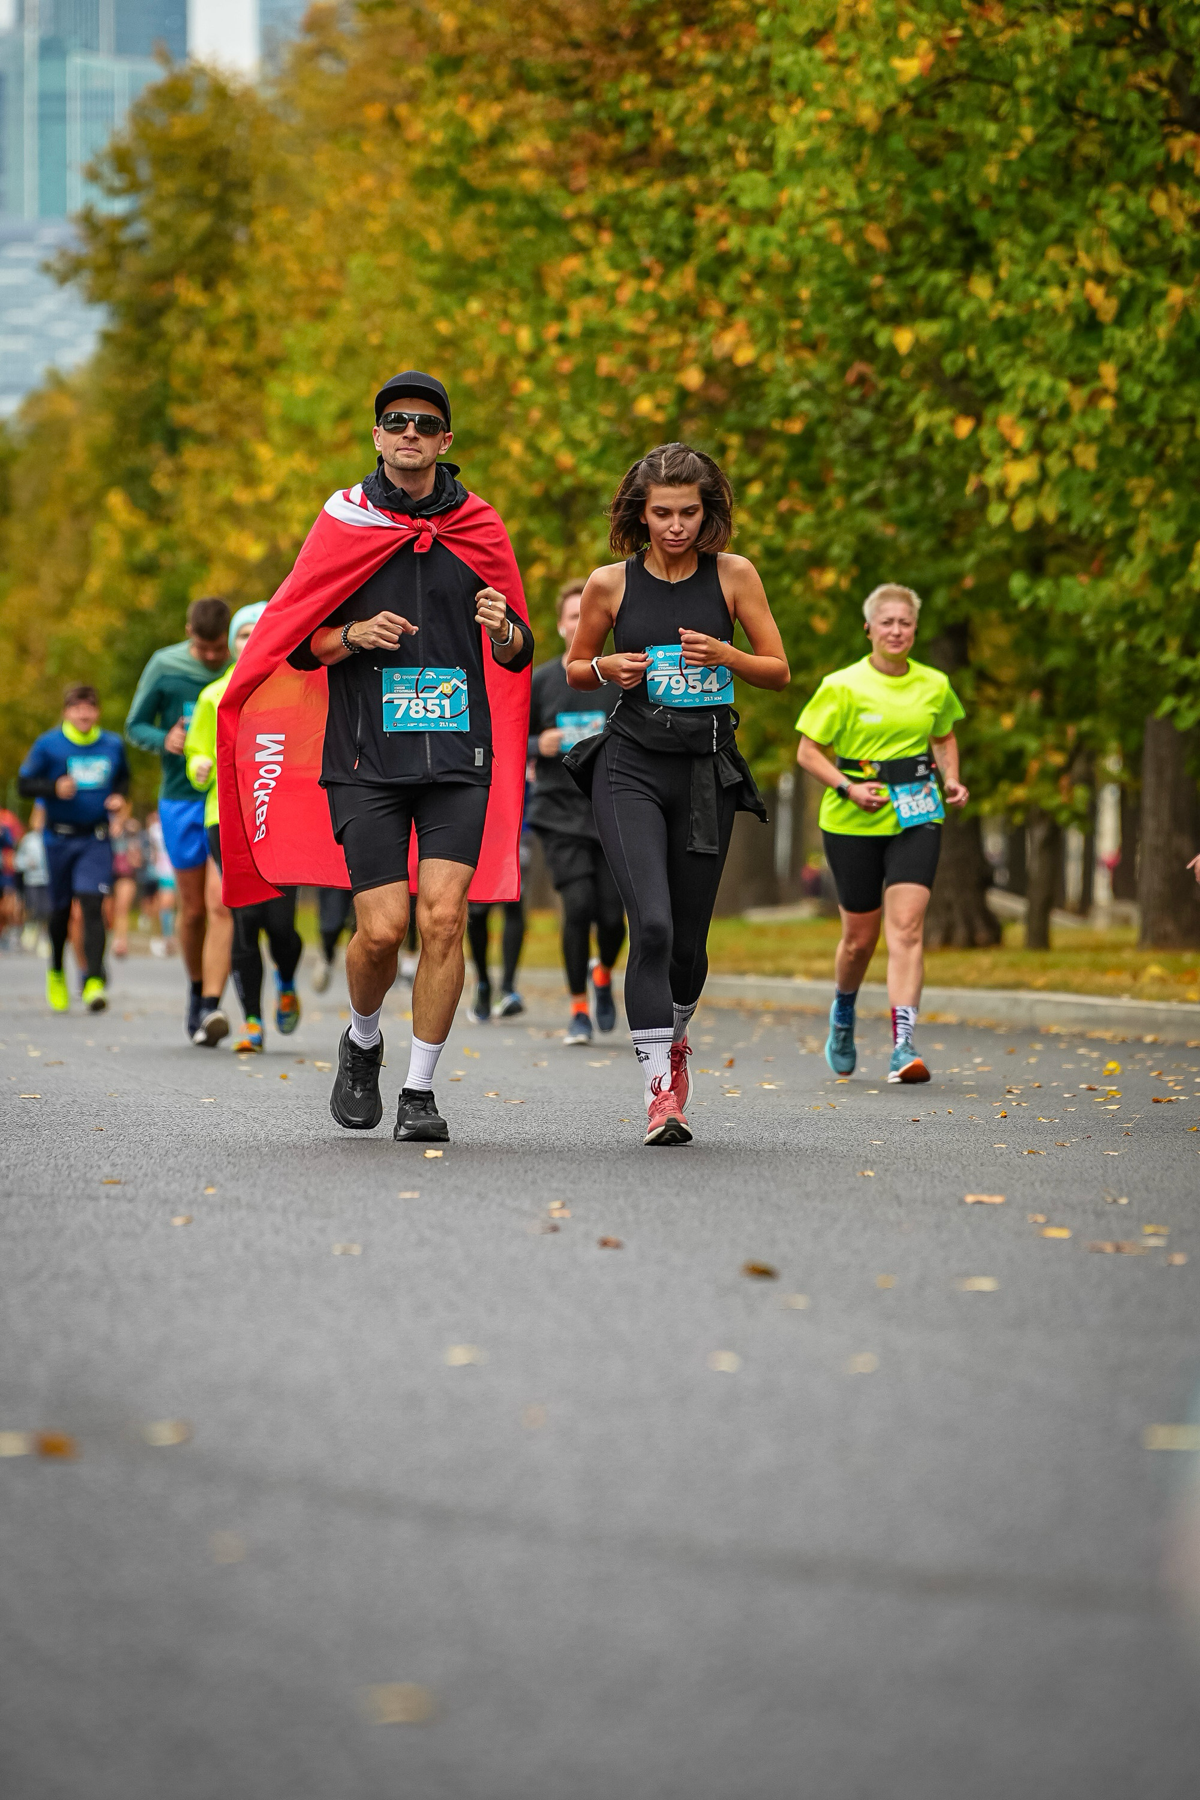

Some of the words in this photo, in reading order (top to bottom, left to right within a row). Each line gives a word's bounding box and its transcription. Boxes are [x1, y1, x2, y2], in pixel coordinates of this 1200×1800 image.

[444, 684, 451, 692] D
[654, 672, 720, 696] 7954
[393, 698, 451, 719] 7851
[898, 797, 937, 818] 8388
